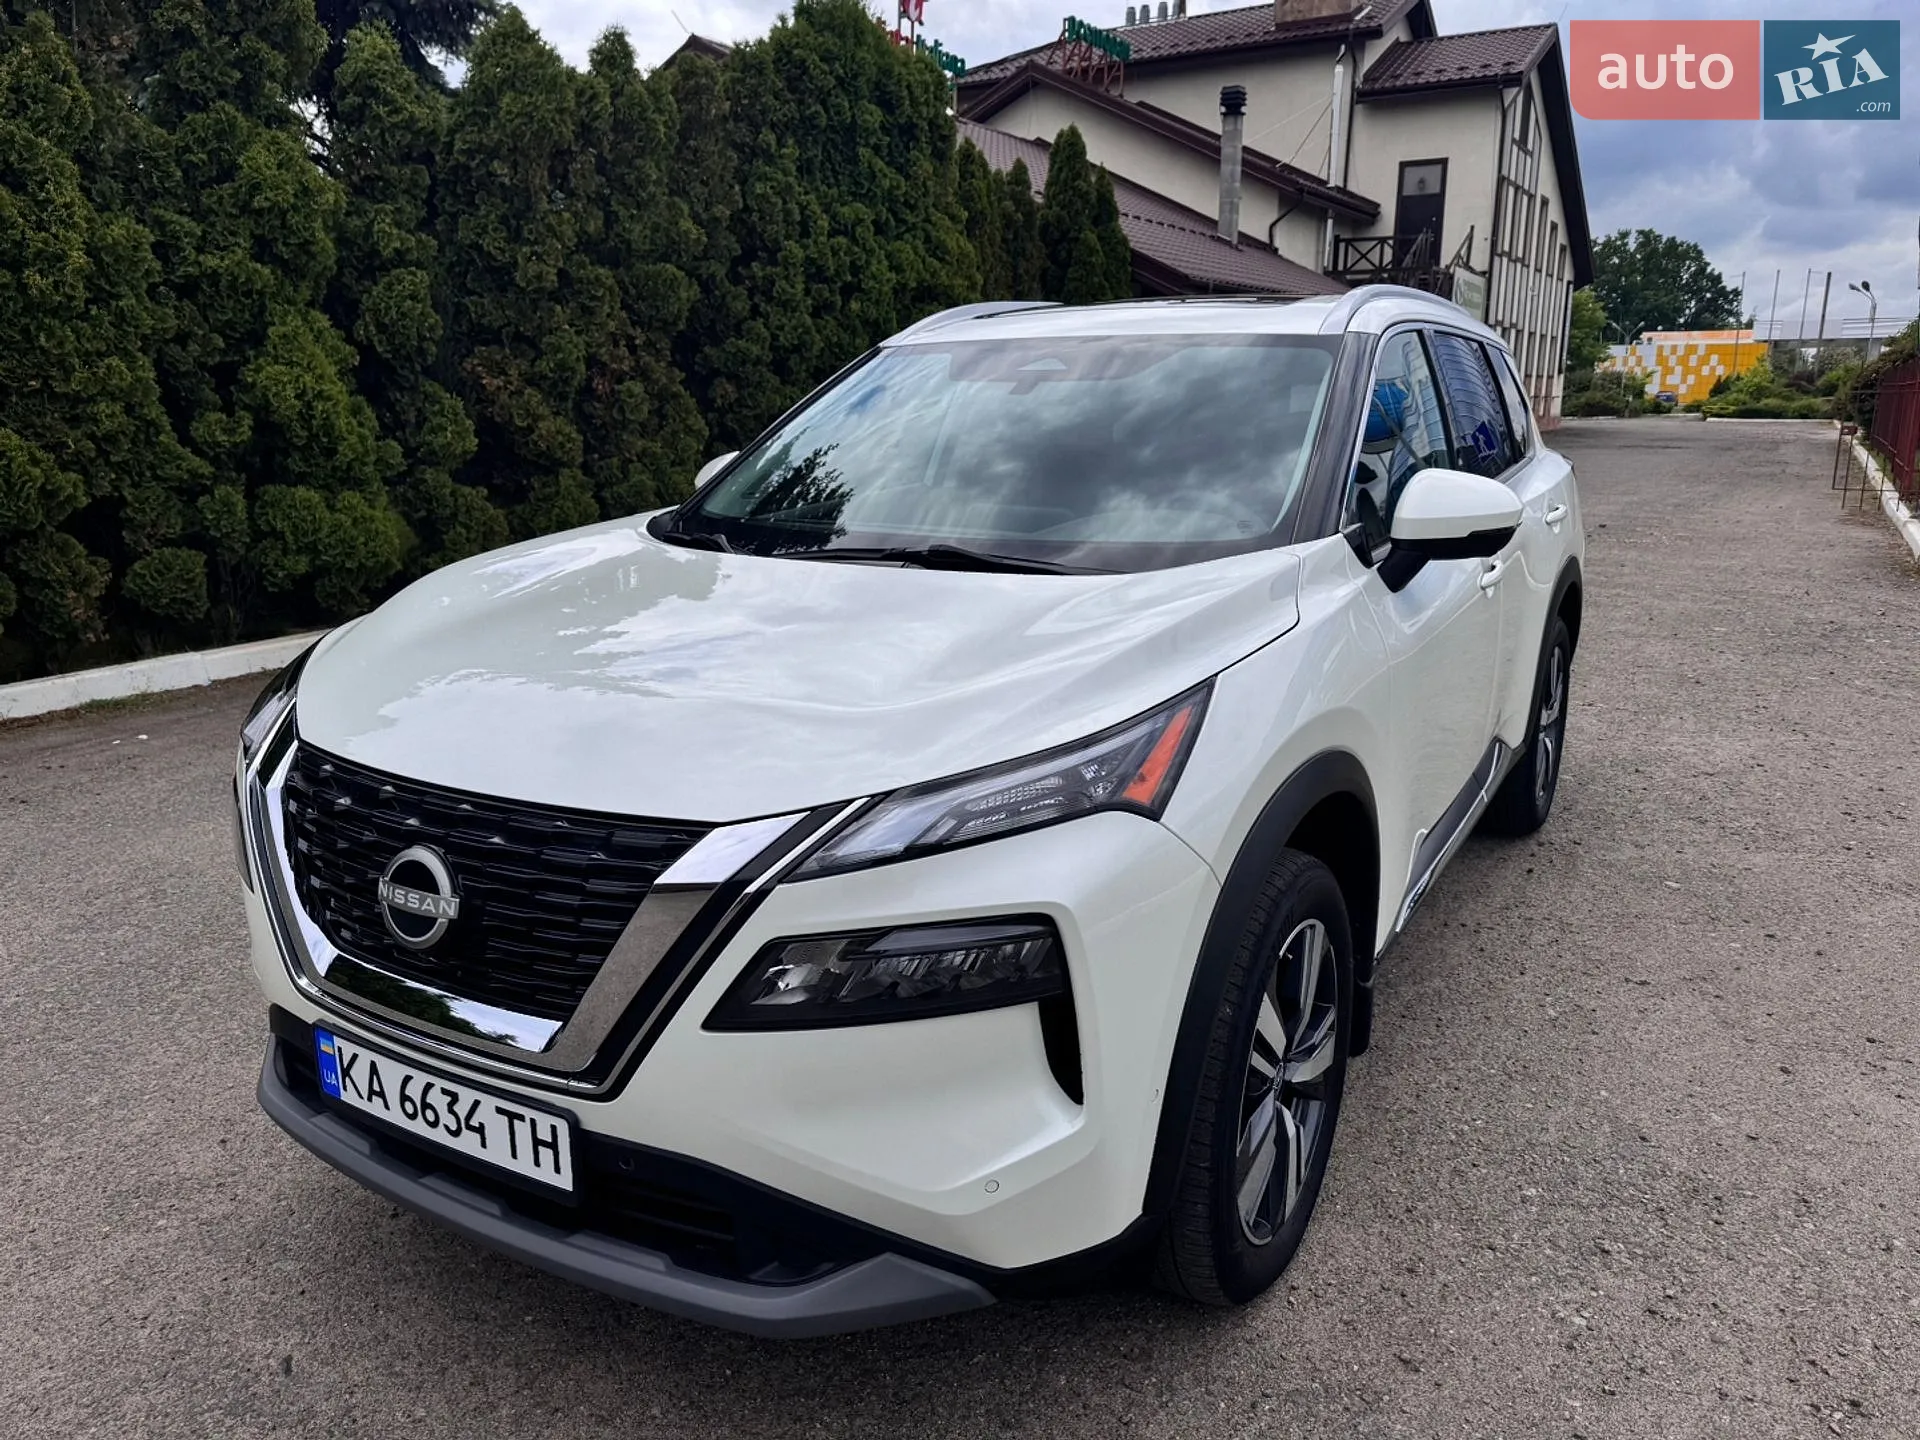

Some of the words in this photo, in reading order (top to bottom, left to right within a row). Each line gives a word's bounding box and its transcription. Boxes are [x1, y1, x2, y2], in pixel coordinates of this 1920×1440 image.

[379, 881, 455, 916] NISSAN
[323, 1068, 338, 1087] UA
[337, 1045, 390, 1111] KA
[400, 1074, 487, 1150] 6634
[495, 1105, 561, 1175] TH
